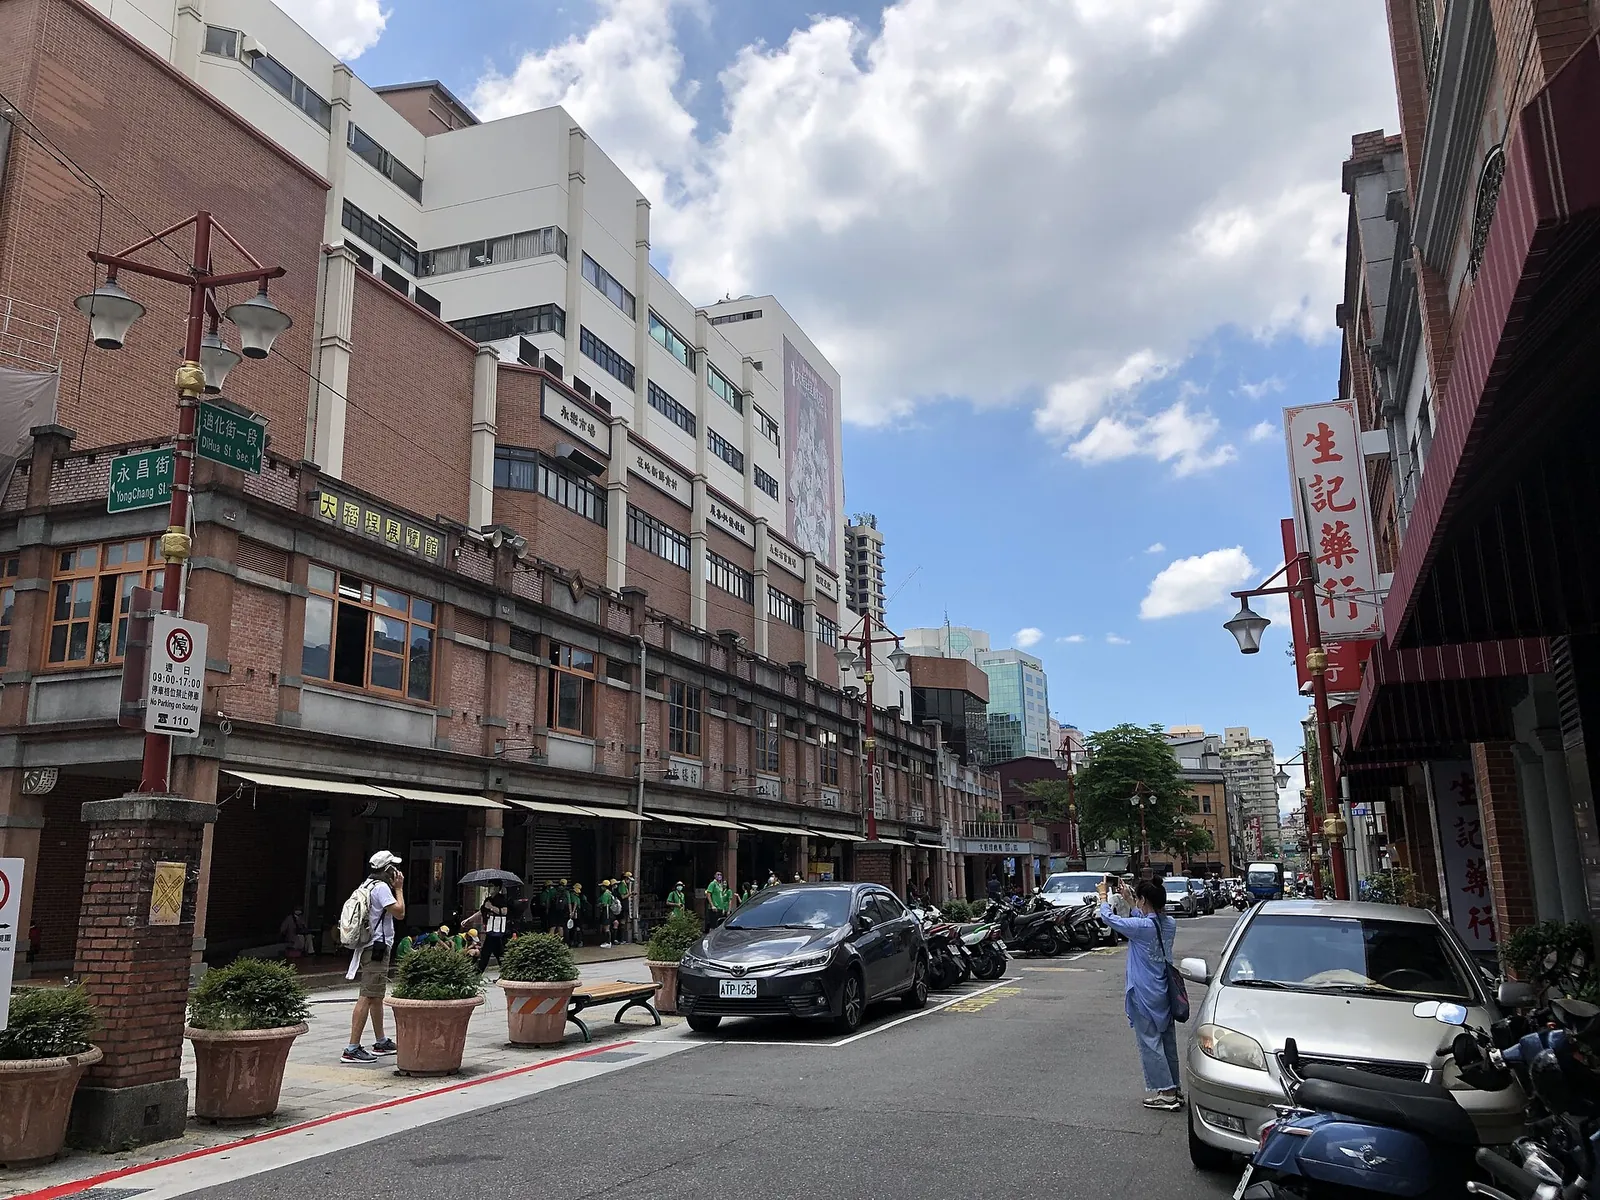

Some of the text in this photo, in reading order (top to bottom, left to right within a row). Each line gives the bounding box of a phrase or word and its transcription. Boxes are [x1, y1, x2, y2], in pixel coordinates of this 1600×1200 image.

[203, 410, 257, 447] 迪化街一段
[201, 436, 221, 453] DiHua
[224, 444, 233, 457] St.
[236, 449, 250, 463] Sec.
[117, 455, 170, 483] 永昌街
[116, 483, 168, 504] YongChang St.
[321, 495, 437, 557] 大稻埕展覽館
[1303, 422, 1366, 620] 生記藥行
[165, 663, 190, 675] 週日
[152, 672, 201, 688] 09:00-17:00
[150, 698, 157, 706] No
[158, 699, 174, 710] Parking
[182, 703, 198, 713] Sunday
[173, 716, 189, 726] 110
[720, 982, 757, 997] ATP-1256
